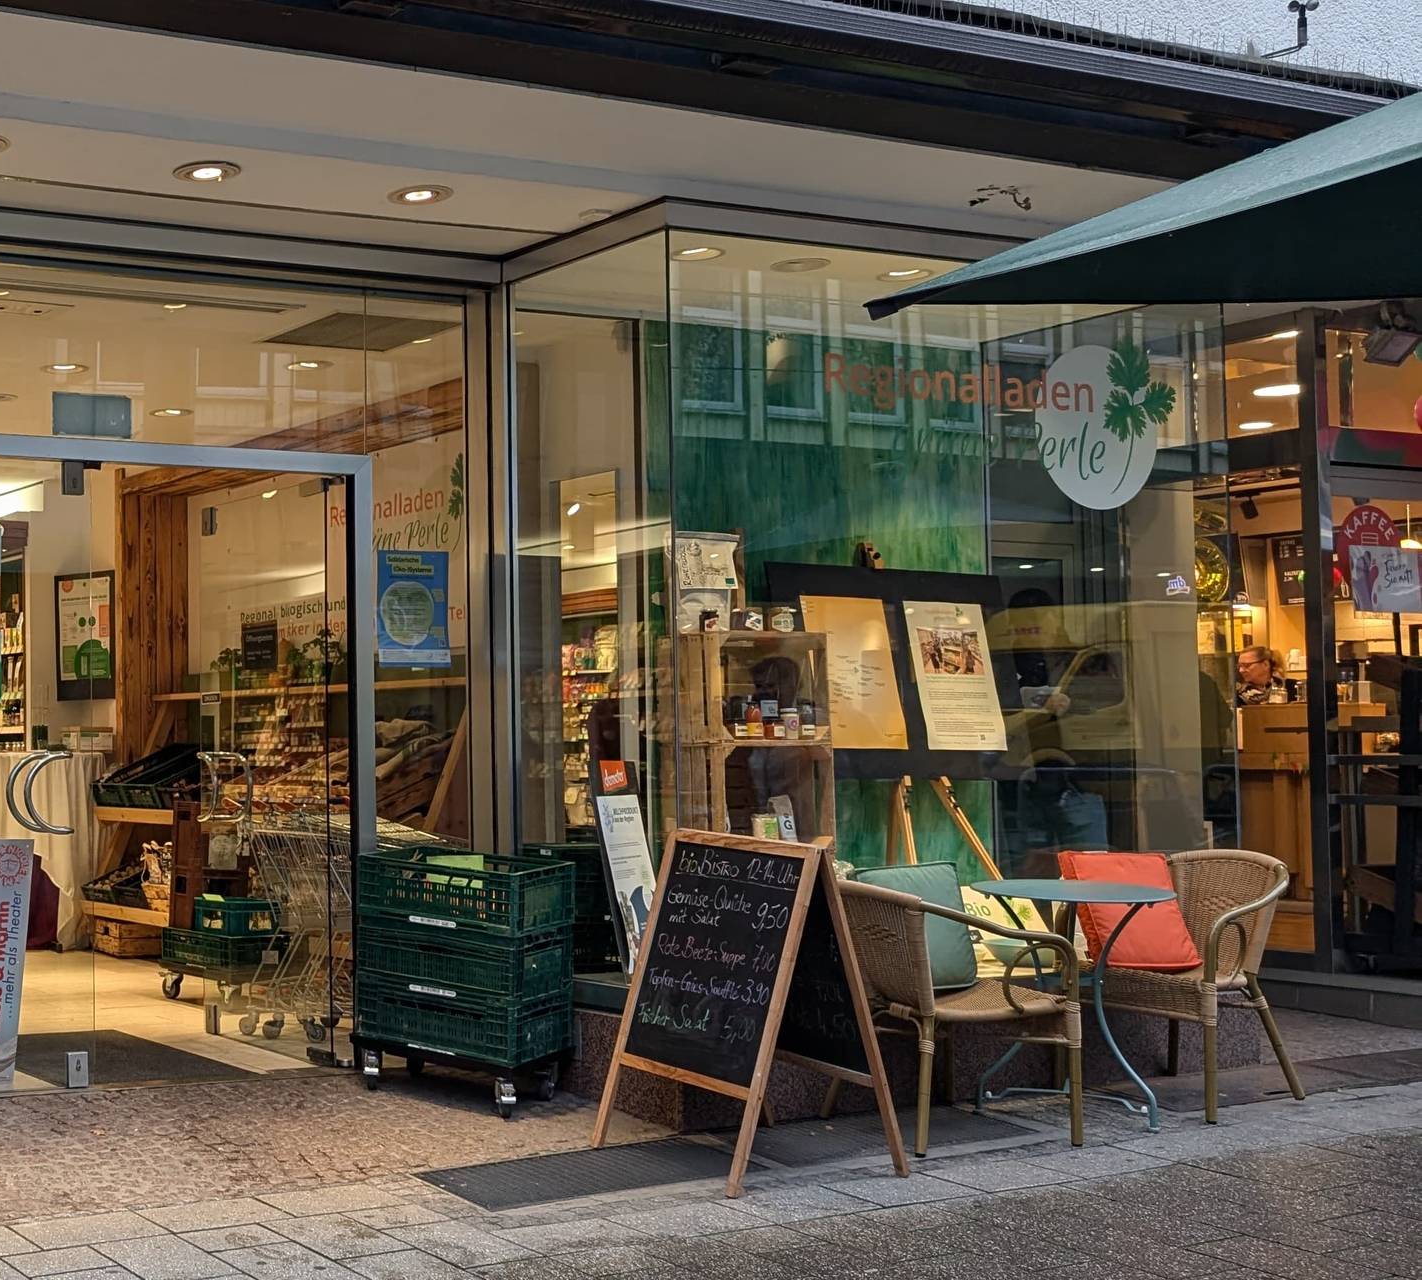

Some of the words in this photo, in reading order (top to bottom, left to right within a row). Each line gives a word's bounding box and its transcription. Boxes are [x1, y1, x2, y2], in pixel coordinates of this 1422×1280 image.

[823, 352, 1094, 413] Regionalladen
[404, 513, 450, 551] Perle
[1343, 510, 1396, 541] KAFFEE
[326, 596, 345, 612] und
[449, 606, 466, 621] Tel
[746, 857, 776, 884] 12-14
[777, 860, 801, 884] Uhr
[7, 890, 22, 941] Theater
[667, 883, 752, 915] Gemüse-Quiche
[752, 902, 789, 931] 9,50
[668, 908, 687, 924] mit
[965, 902, 991, 918] Bio
[7, 947, 17, 965] als
[657, 932, 680, 955] Rote
[752, 944, 777, 973] 7,00
[741, 978, 770, 1006] 3,90
[673, 1003, 710, 1032] Saat
[719, 1014, 757, 1044] 5,00
